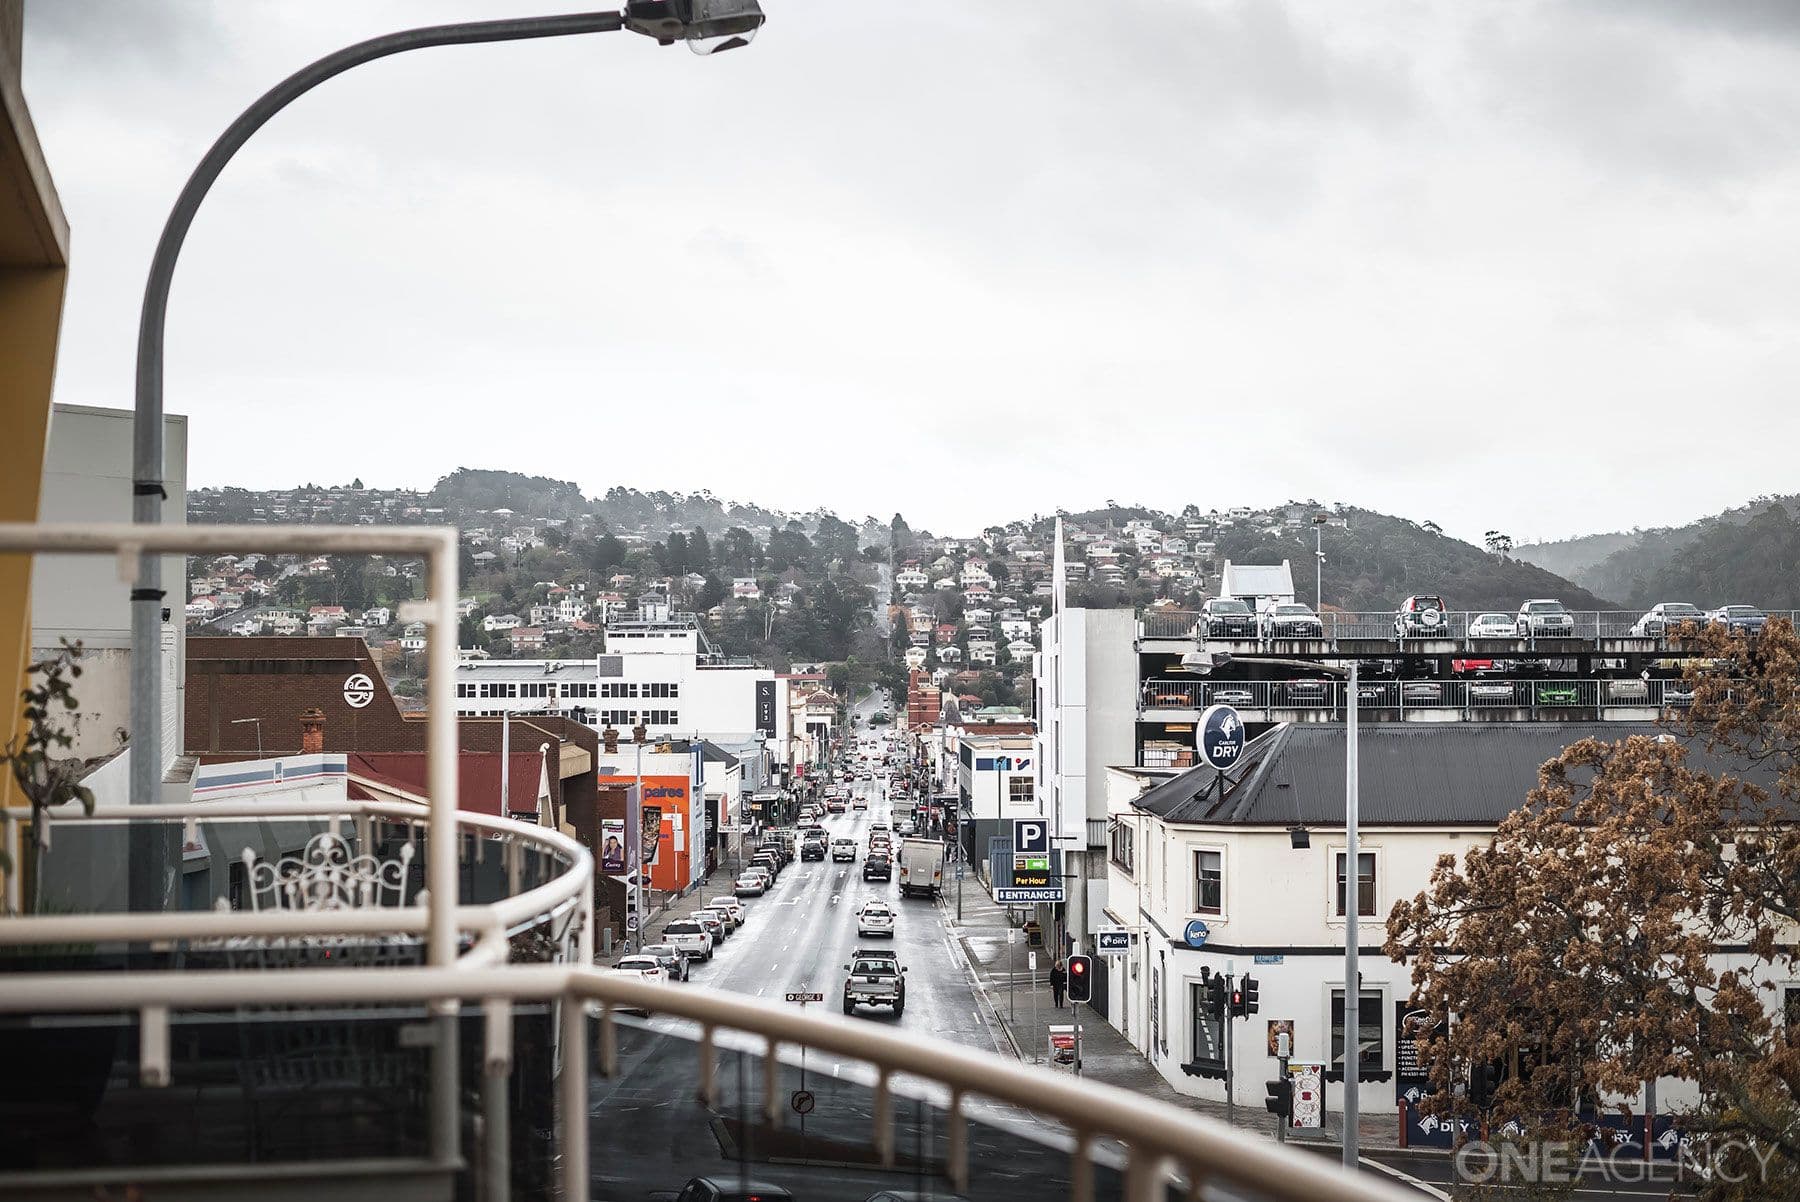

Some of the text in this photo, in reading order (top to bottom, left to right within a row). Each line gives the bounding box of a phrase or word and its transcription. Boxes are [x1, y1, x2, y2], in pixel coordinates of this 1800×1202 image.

[1213, 745, 1239, 758] DRY
[644, 785, 684, 801] paires
[1022, 824, 1041, 849] P
[1015, 877, 1047, 885] Per Hour
[1005, 891, 1056, 900] ENTRANCE
[795, 993, 815, 1001] GEORGE
[1440, 1122, 1469, 1132] DY
